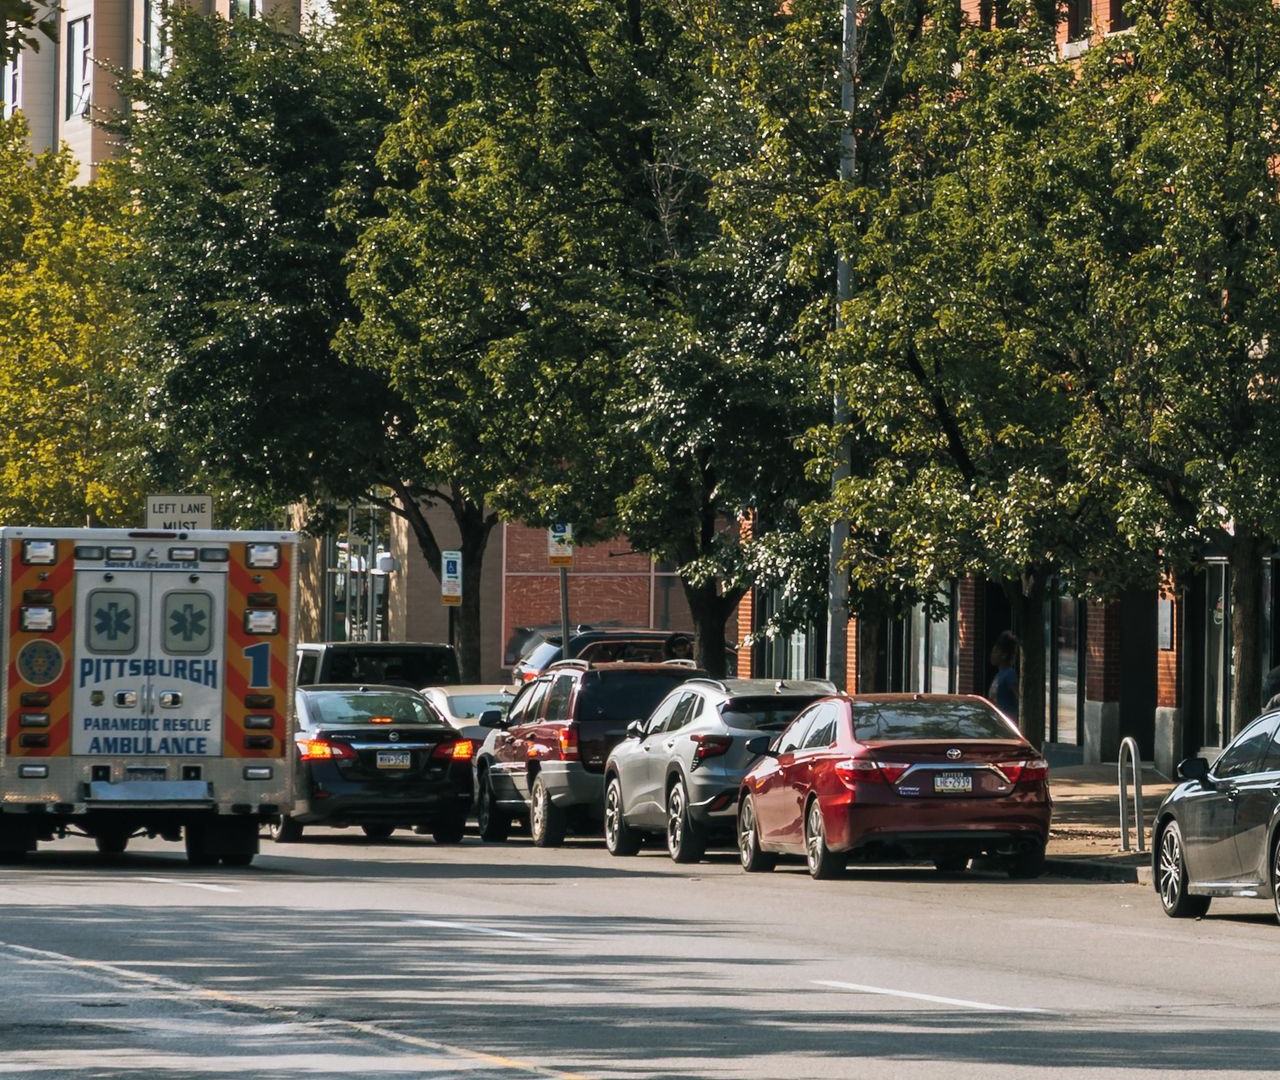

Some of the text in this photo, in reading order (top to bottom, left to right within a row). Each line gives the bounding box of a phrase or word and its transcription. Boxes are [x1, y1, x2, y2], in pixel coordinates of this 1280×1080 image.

[152, 503, 207, 514] LEFT LANE
[162, 521, 197, 530] MUST
[244, 642, 271, 688] 1
[80, 658, 218, 689] PITTSBURGH
[83, 718, 212, 732] PARAMEDIC RESCUE
[88, 737, 207, 754] AMBULANCE
